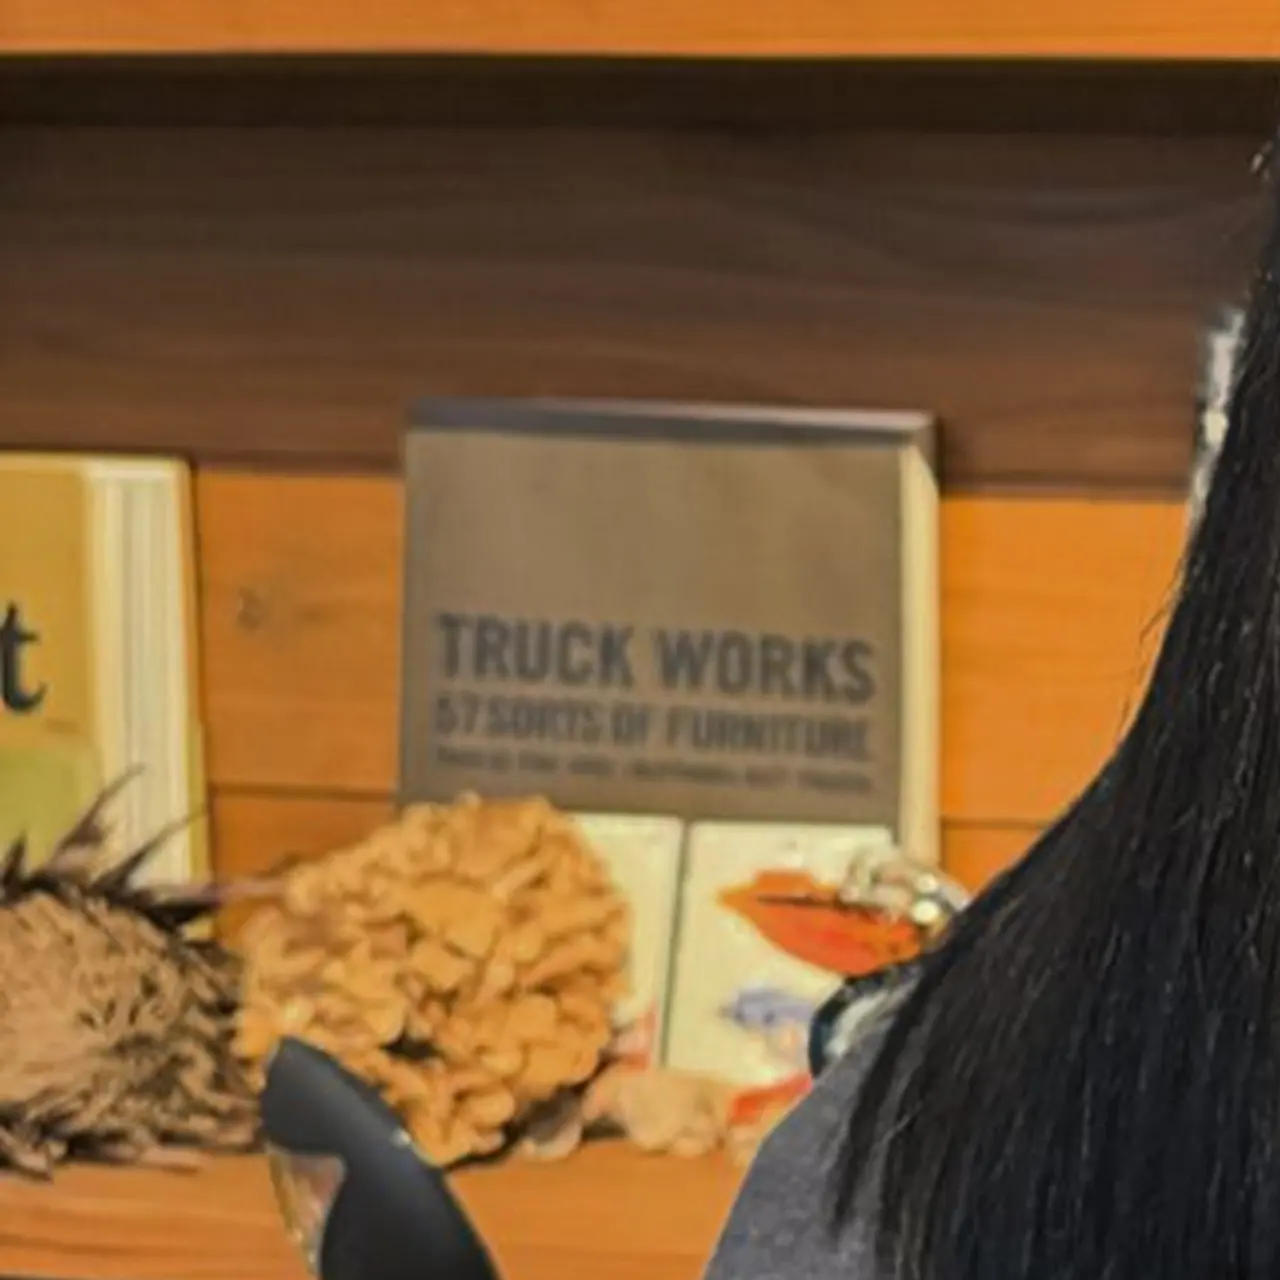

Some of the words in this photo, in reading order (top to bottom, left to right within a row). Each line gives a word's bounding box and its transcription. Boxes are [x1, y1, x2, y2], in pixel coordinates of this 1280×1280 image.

[438, 613, 635, 691] TRUCK
[655, 629, 876, 706] WORKS
[610, 703, 654, 748] OF
